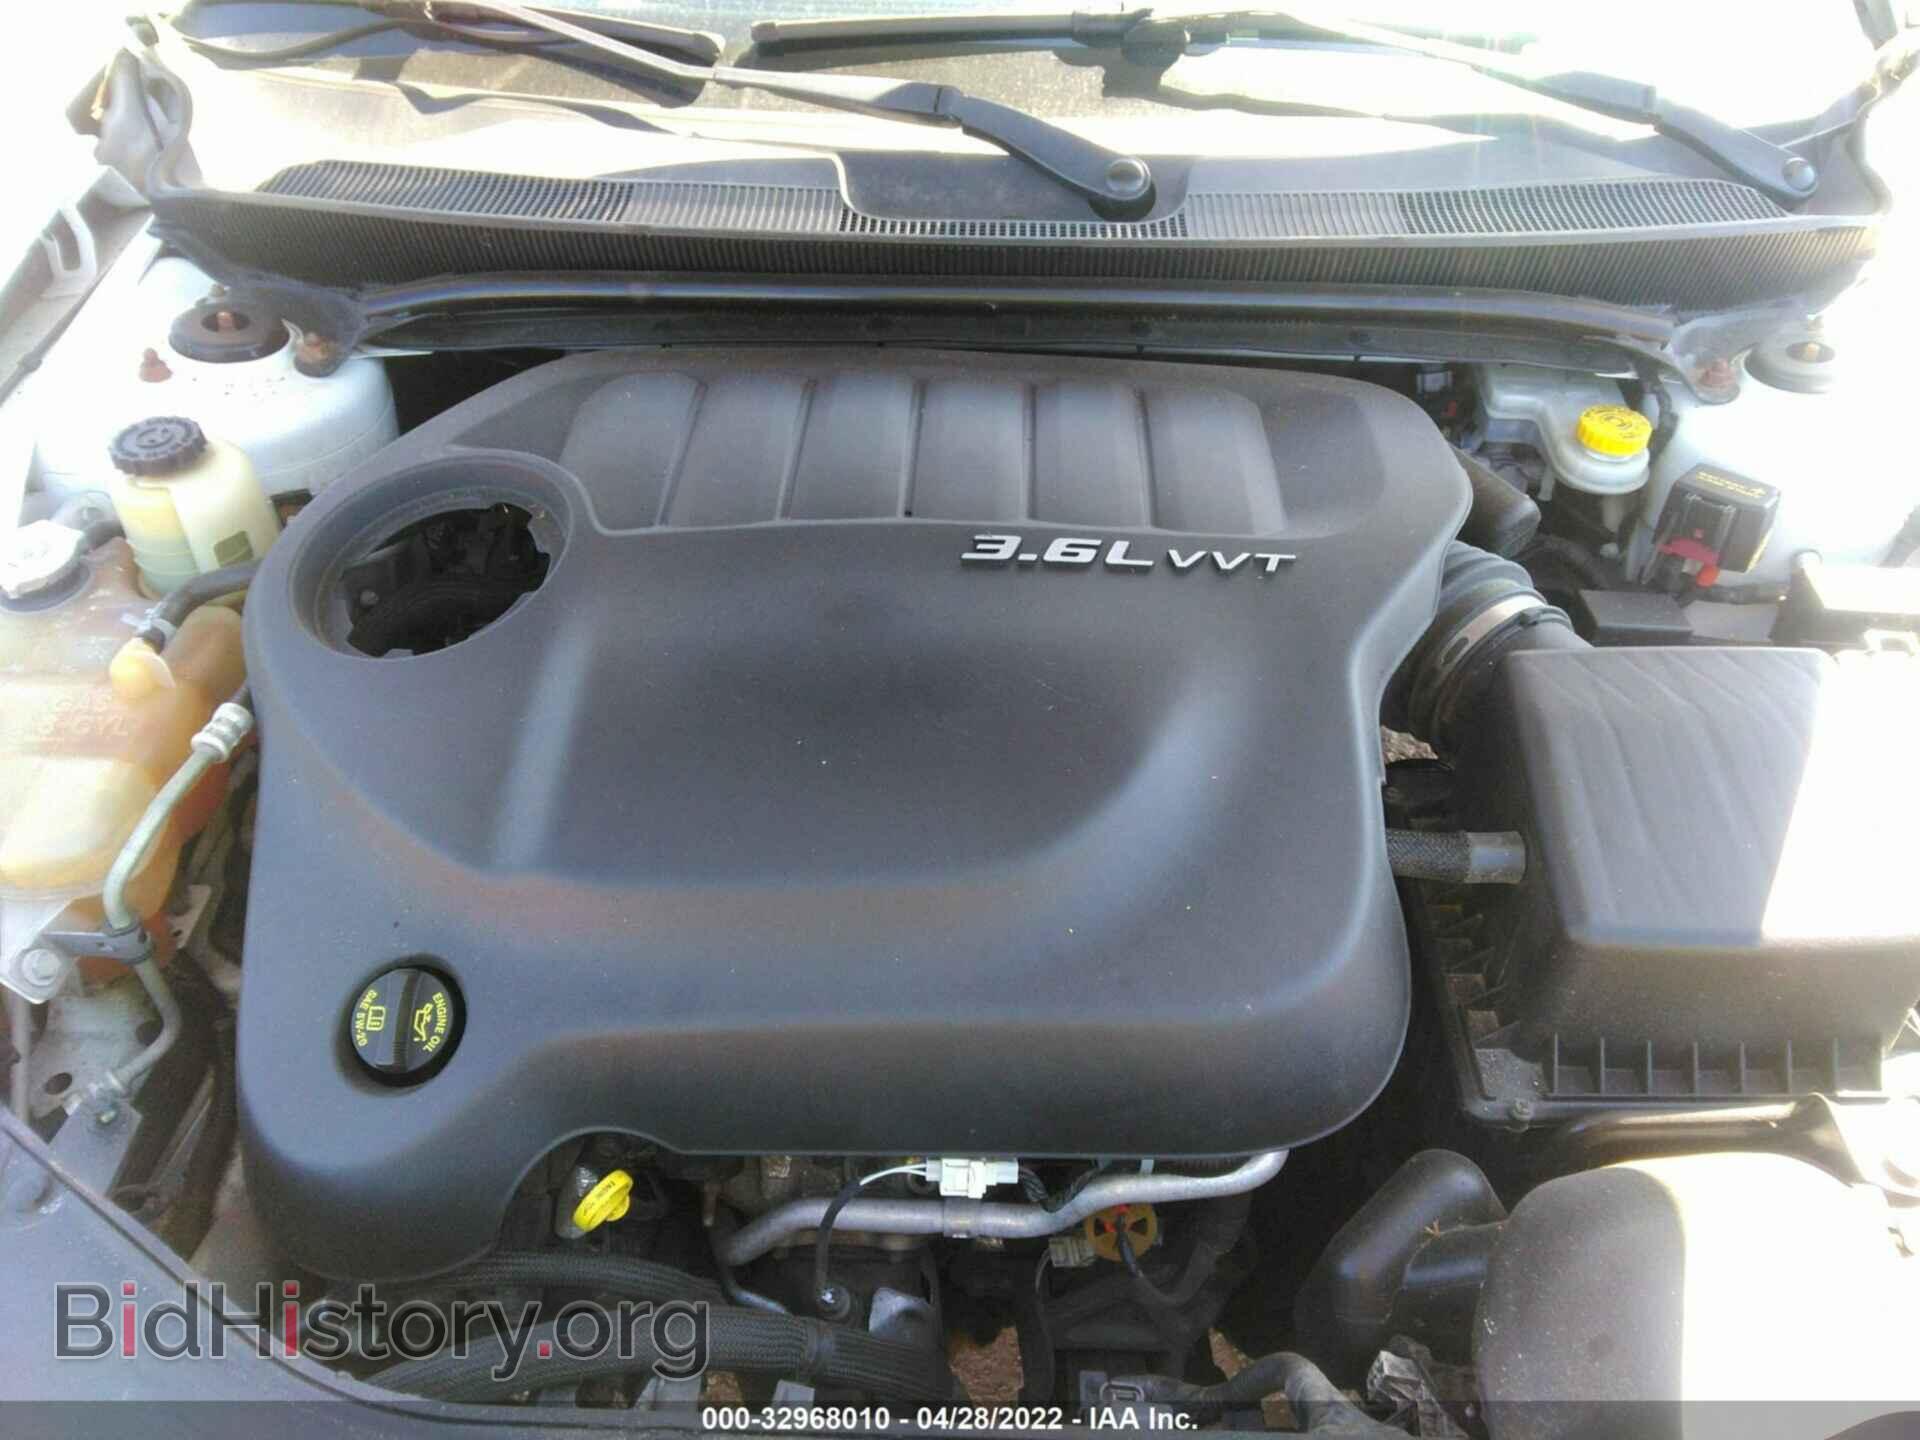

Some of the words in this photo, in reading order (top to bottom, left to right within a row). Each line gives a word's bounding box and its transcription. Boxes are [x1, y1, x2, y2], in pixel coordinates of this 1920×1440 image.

[960, 535, 1155, 567] 3.6L
[1167, 549, 1297, 573] VVT
[432, 991, 448, 1034] ENGINE
[422, 1035, 441, 1052] OIL
